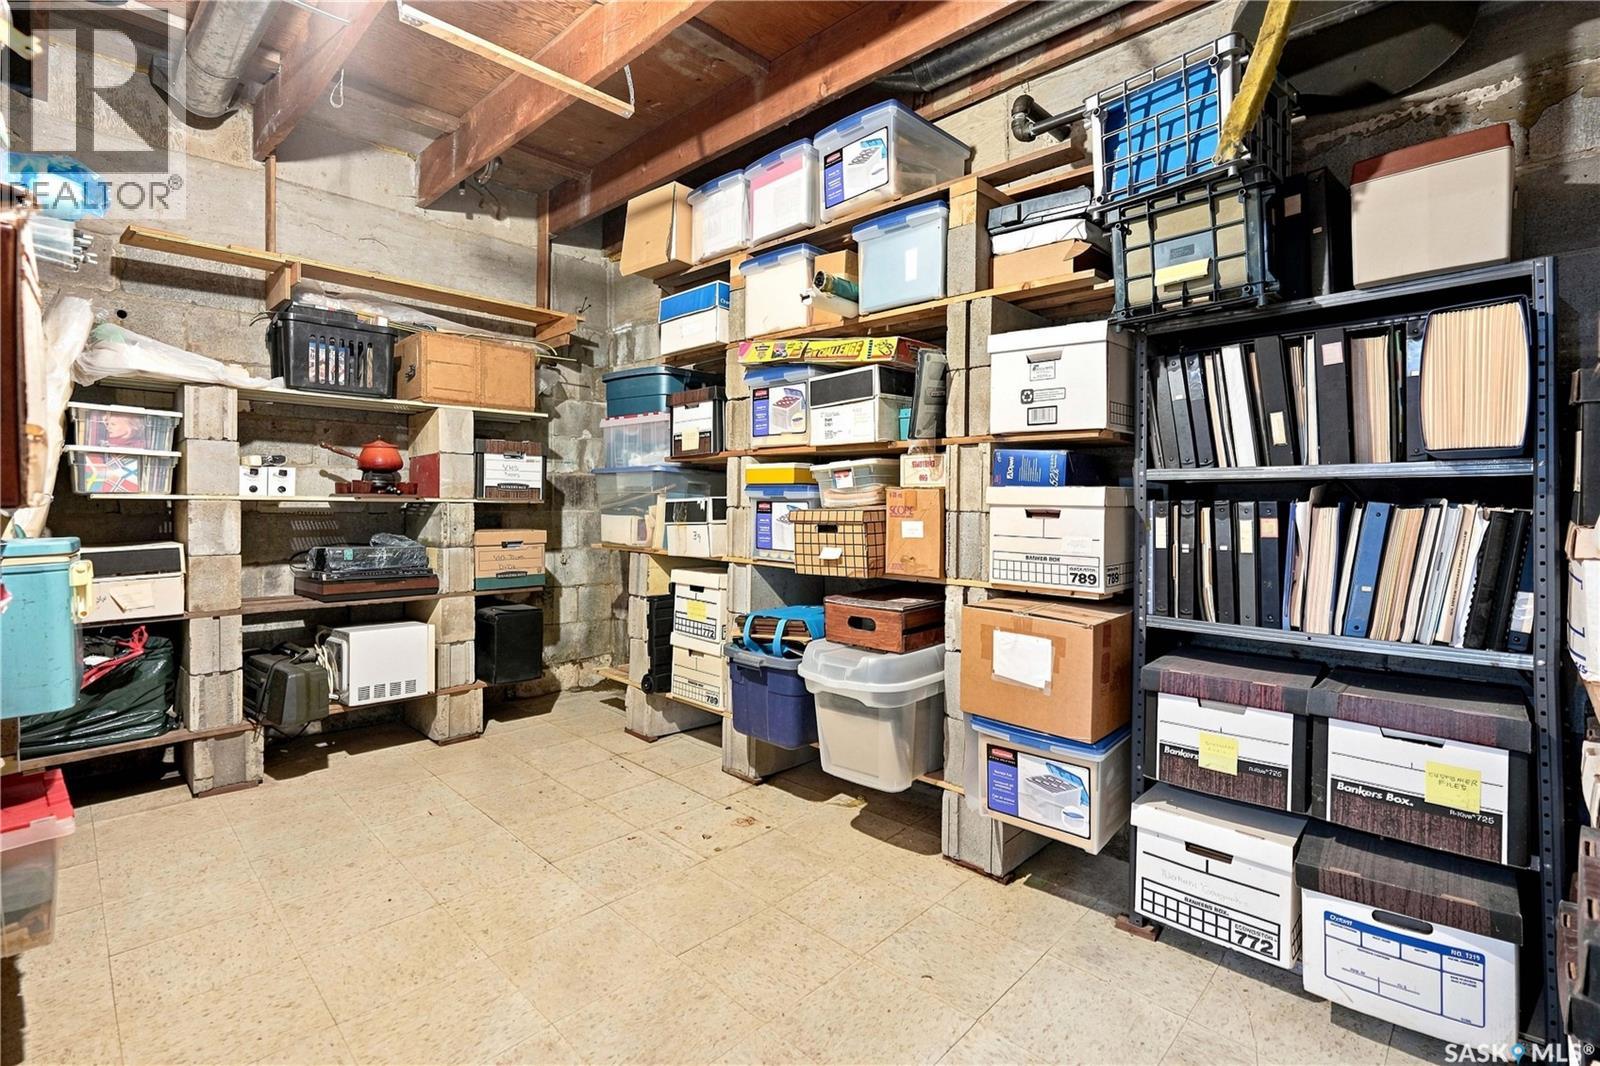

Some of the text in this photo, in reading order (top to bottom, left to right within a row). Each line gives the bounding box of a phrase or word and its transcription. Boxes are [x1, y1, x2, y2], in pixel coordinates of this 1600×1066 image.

[1069, 572, 1097, 585] 789
[703, 628, 714, 638] 772
[706, 694, 719, 706] 789
[1336, 781, 1382, 799] Bankers
[1476, 814, 1496, 826] 725
[1234, 930, 1275, 957] 772
